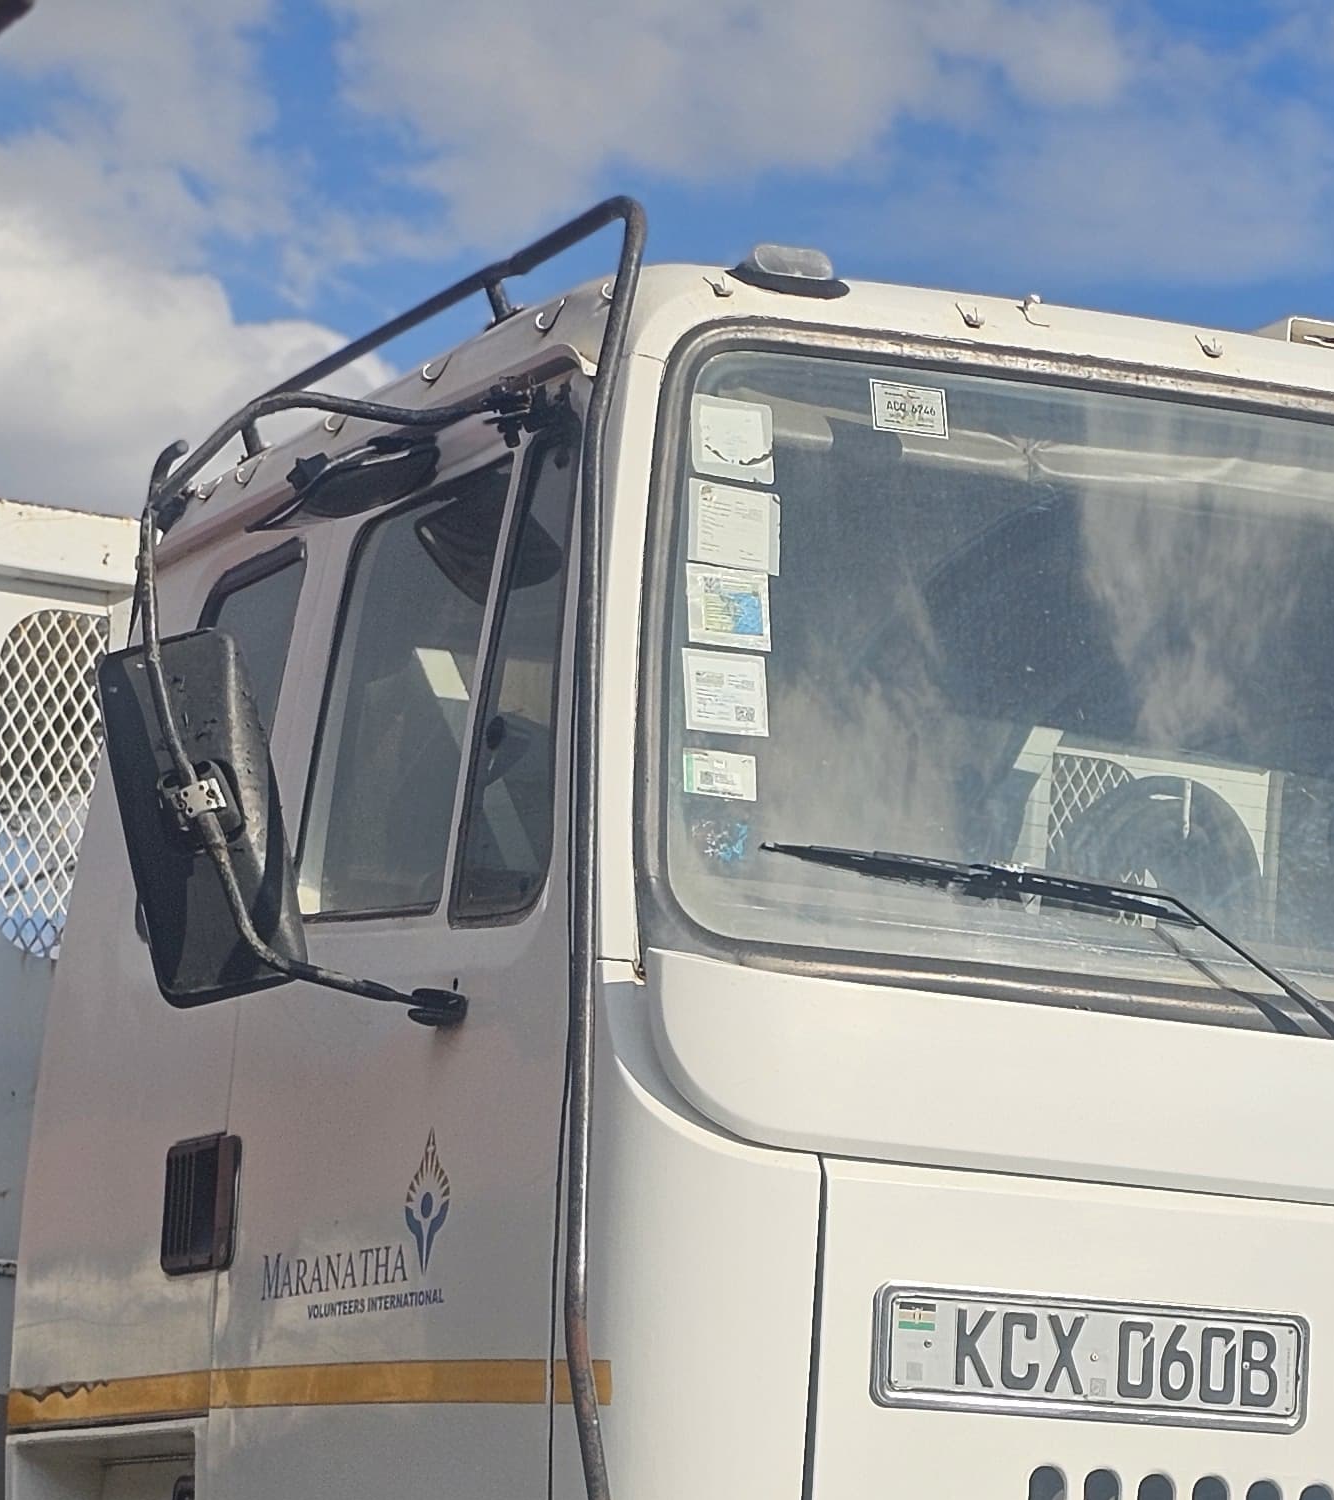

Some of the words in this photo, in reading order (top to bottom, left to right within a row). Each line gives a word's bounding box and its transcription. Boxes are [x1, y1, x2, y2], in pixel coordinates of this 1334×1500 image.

[307, 1298, 366, 1320] VOLUNTEERS
[366, 1288, 445, 1314] INTERNATIONAL
[954, 1306, 1088, 1396] KCX
[1115, 1320, 1280, 1408] 060B
